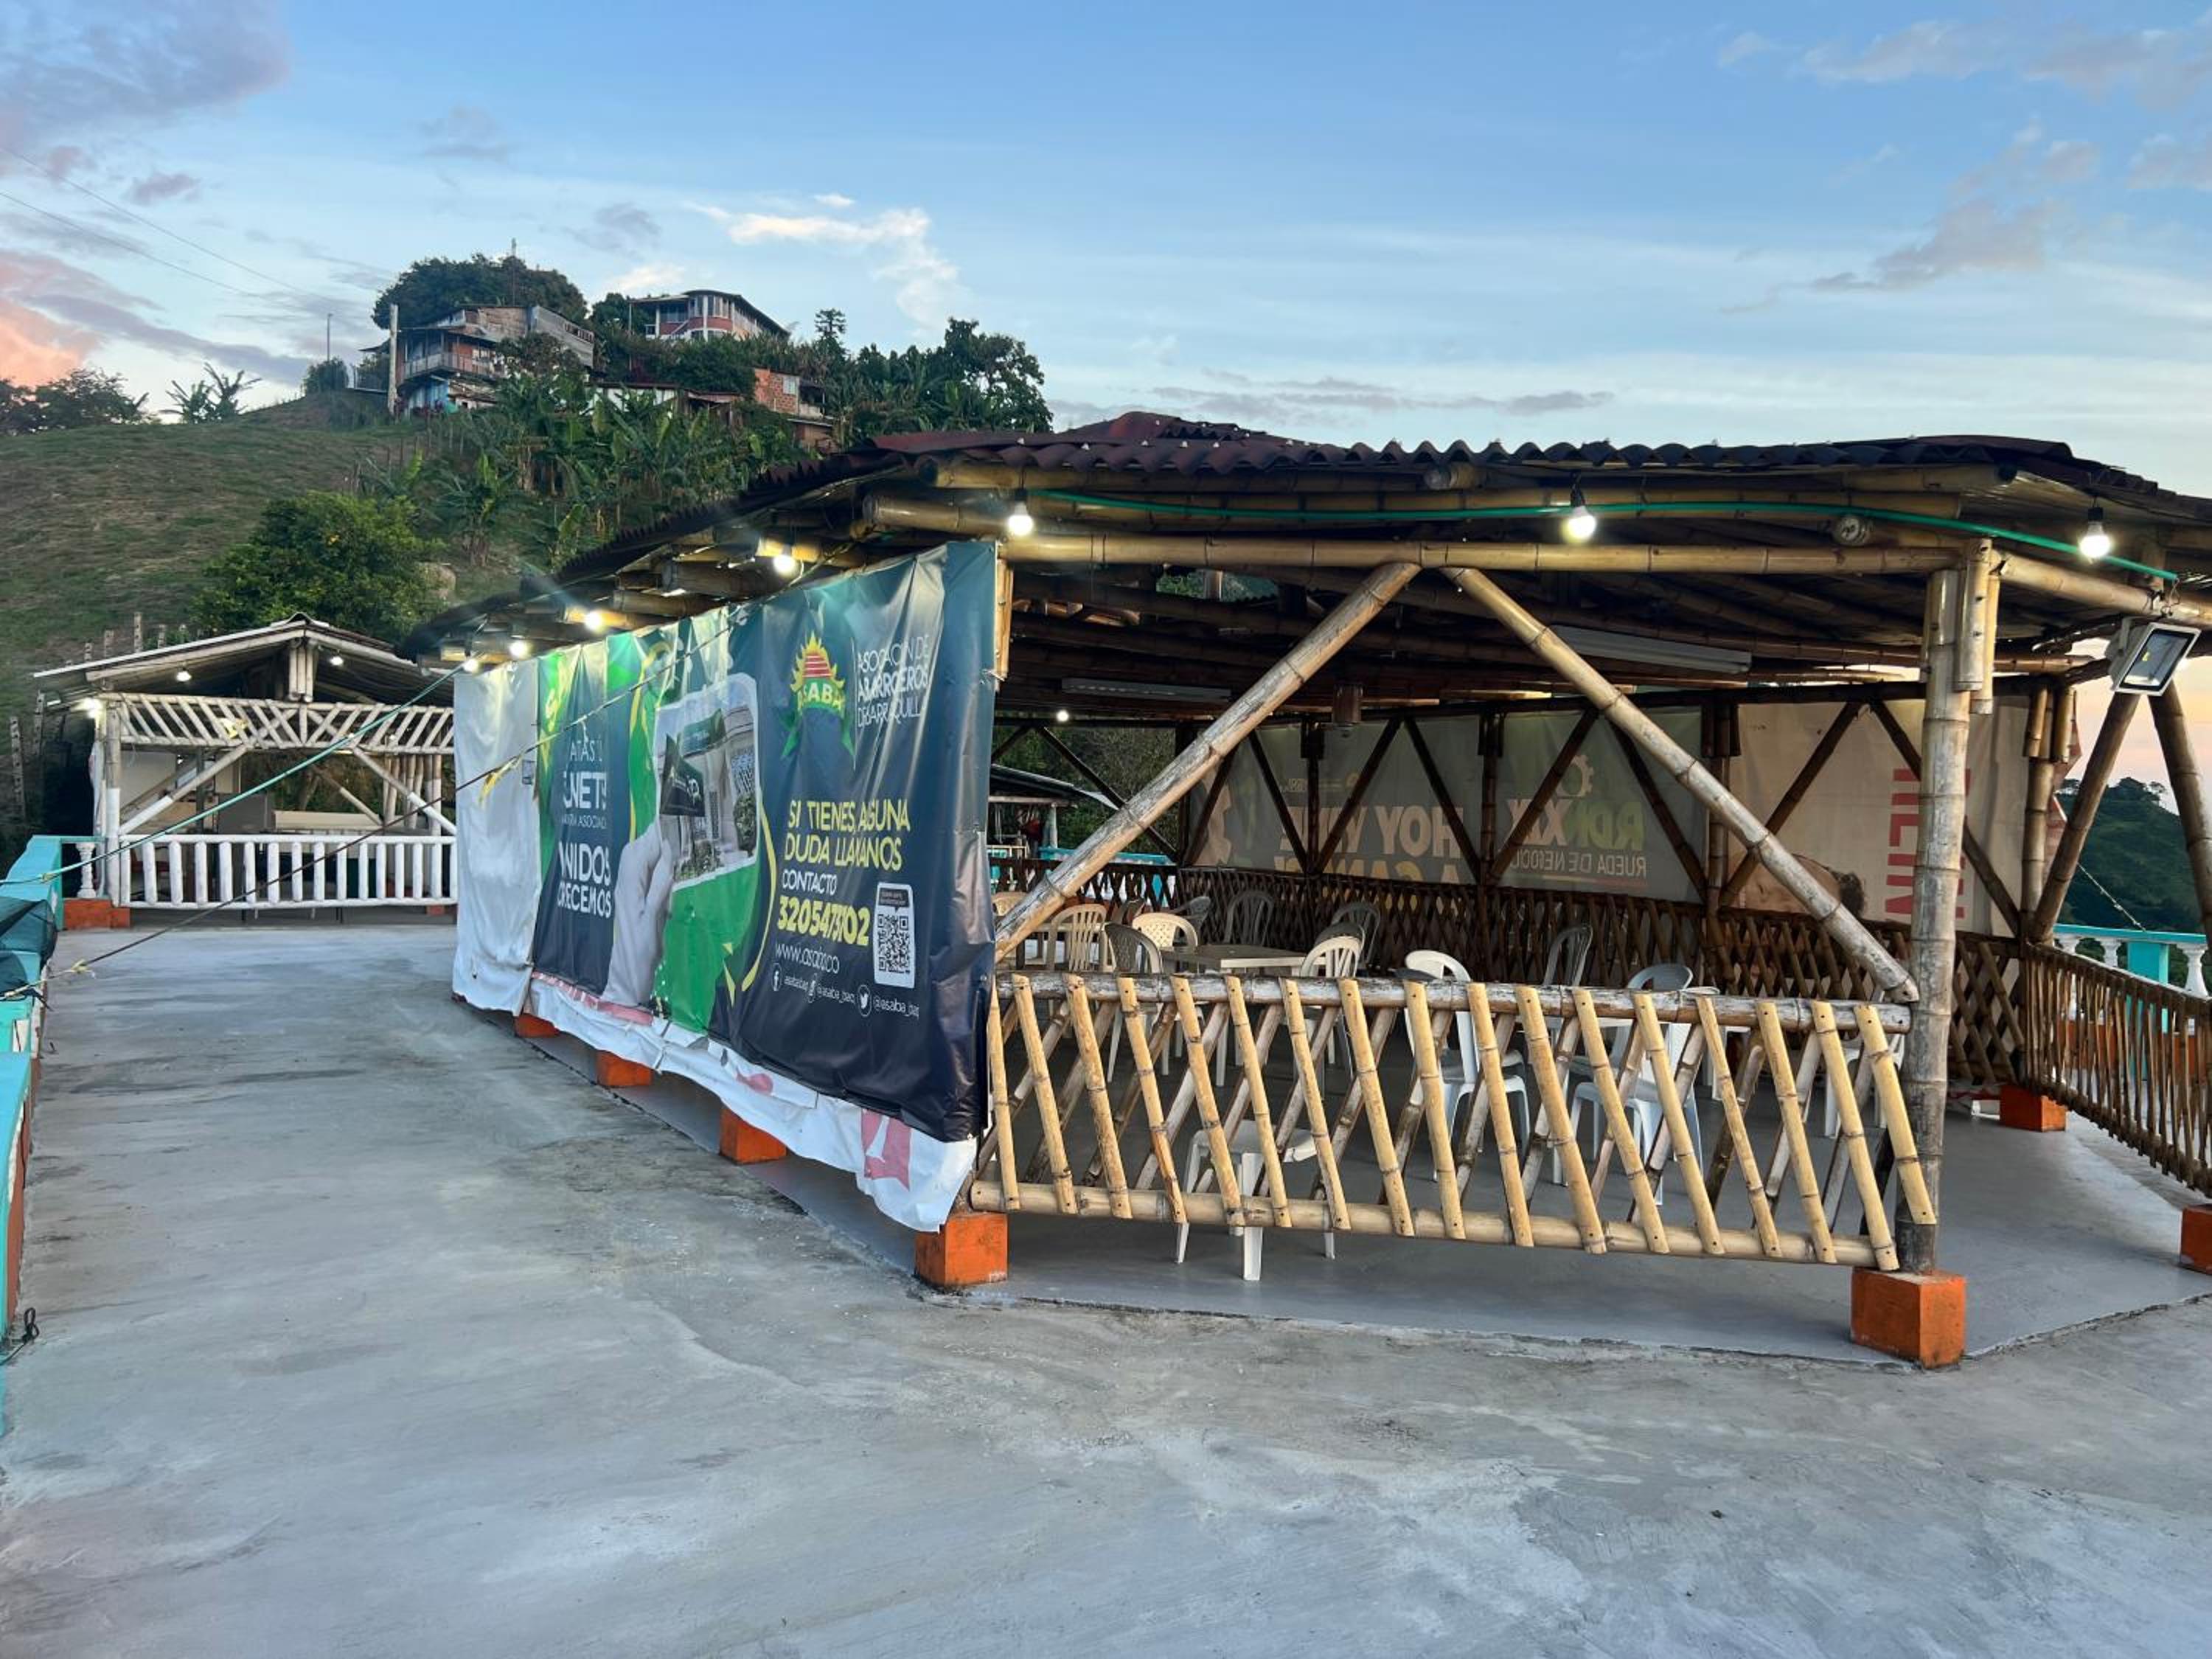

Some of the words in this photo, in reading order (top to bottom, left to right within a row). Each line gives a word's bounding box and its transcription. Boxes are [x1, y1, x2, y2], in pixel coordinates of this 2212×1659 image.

[787, 799, 802, 828] SI
[784, 833, 830, 866] DUDA
[782, 869, 838, 896] CONTACTO
